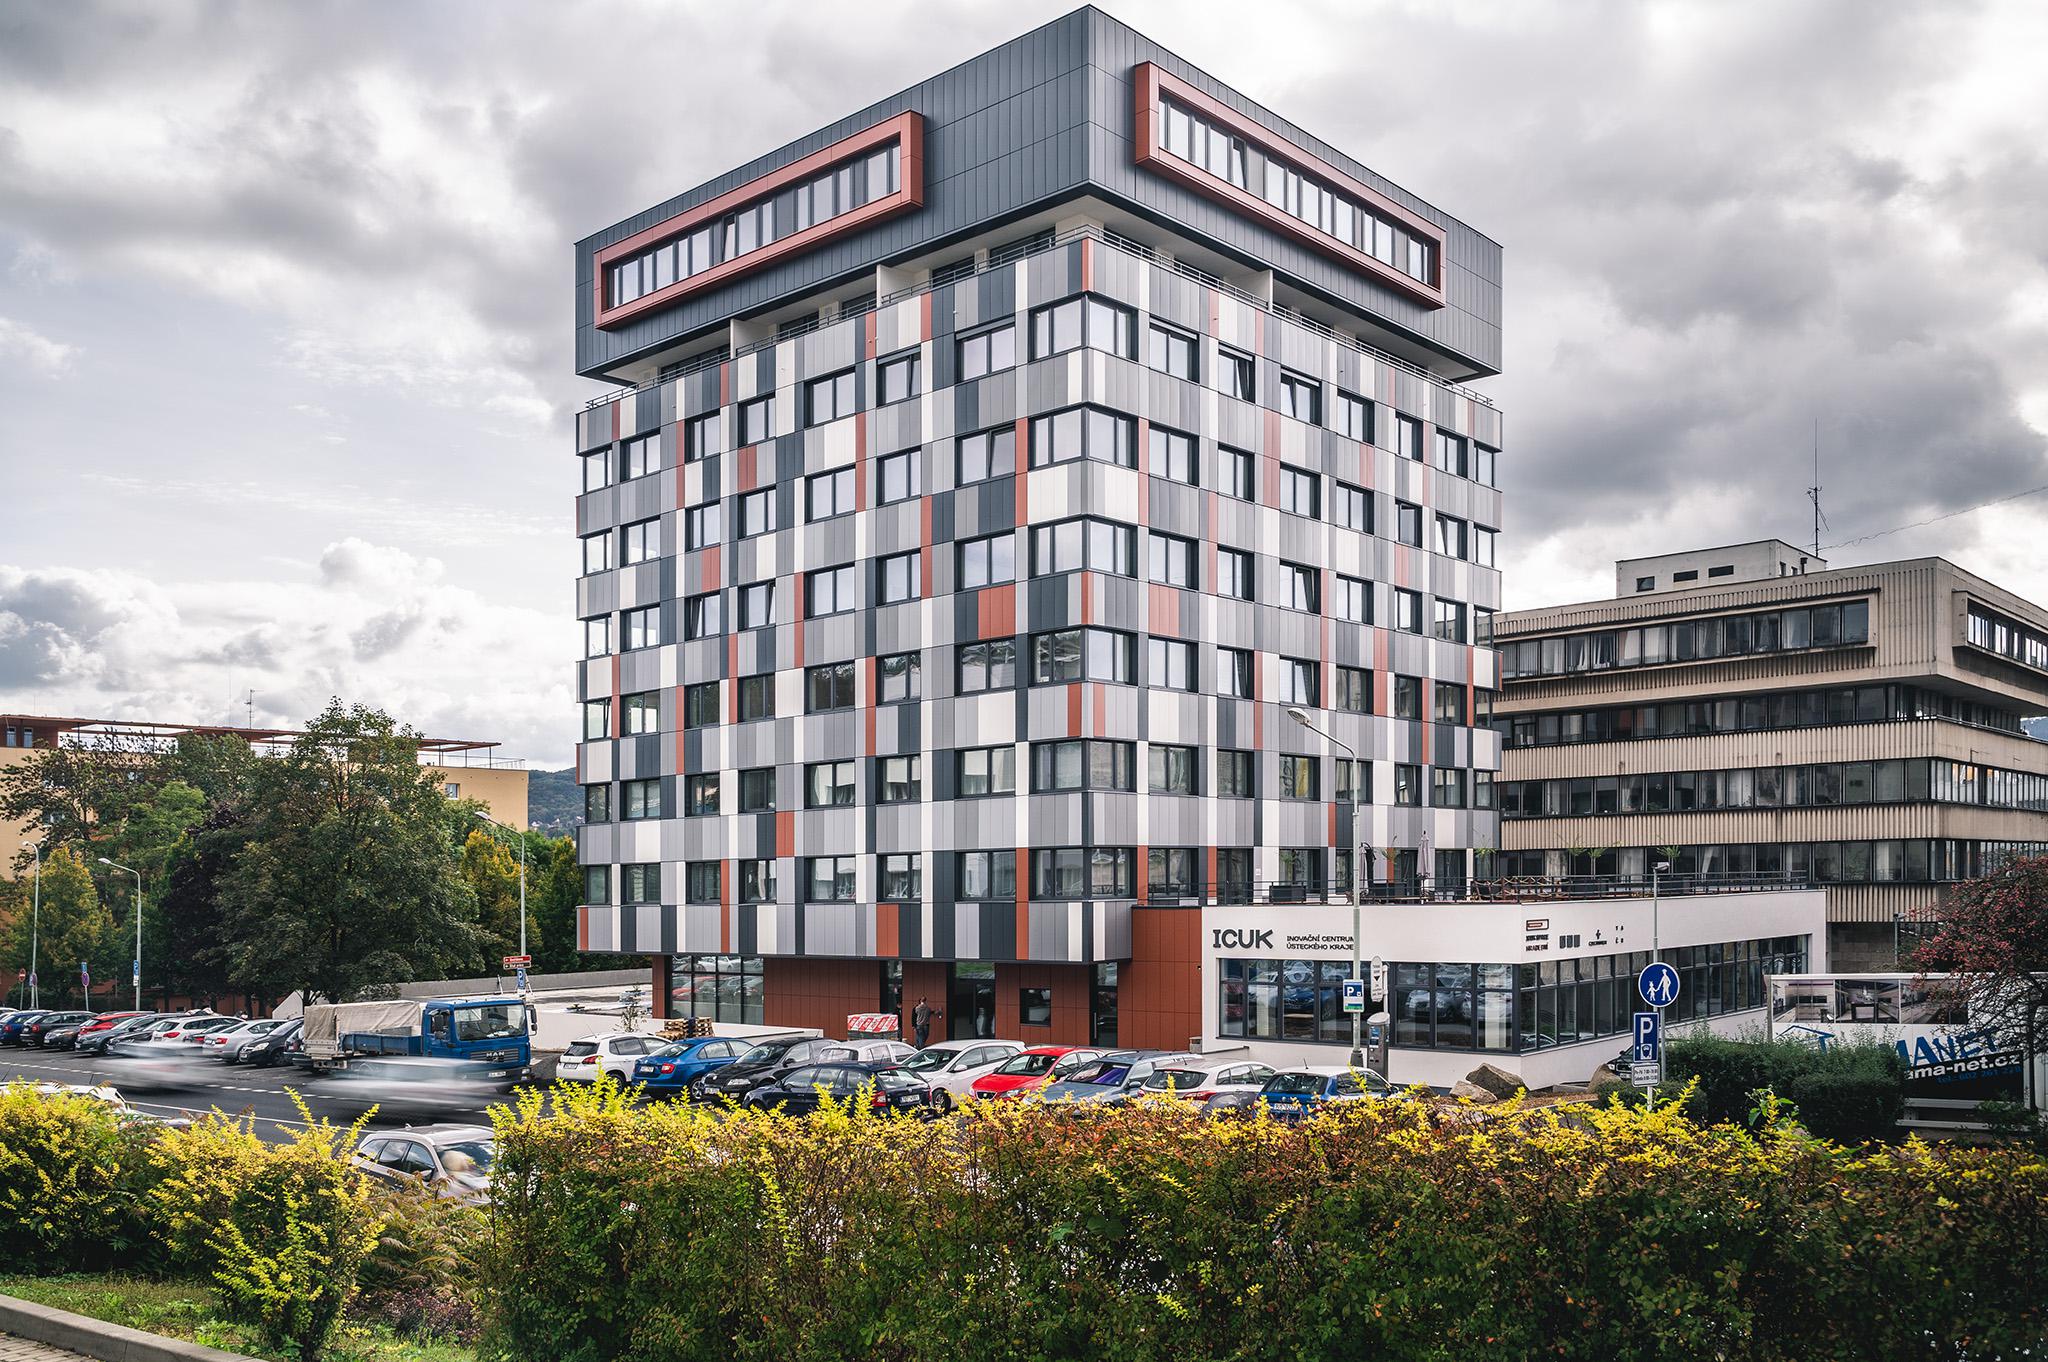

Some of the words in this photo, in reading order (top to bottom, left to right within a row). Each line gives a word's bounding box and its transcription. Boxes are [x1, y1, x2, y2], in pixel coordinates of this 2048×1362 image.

[1213, 929, 1274, 949] ICUK
[1286, 933, 1321, 942] INOVAČNÍ
[1286, 942, 1328, 950] ÚSTECKÉHO
[1329, 943, 1354, 951] KRAJE
[1347, 986, 1354, 997] P
[1639, 1017, 1653, 1044] P
